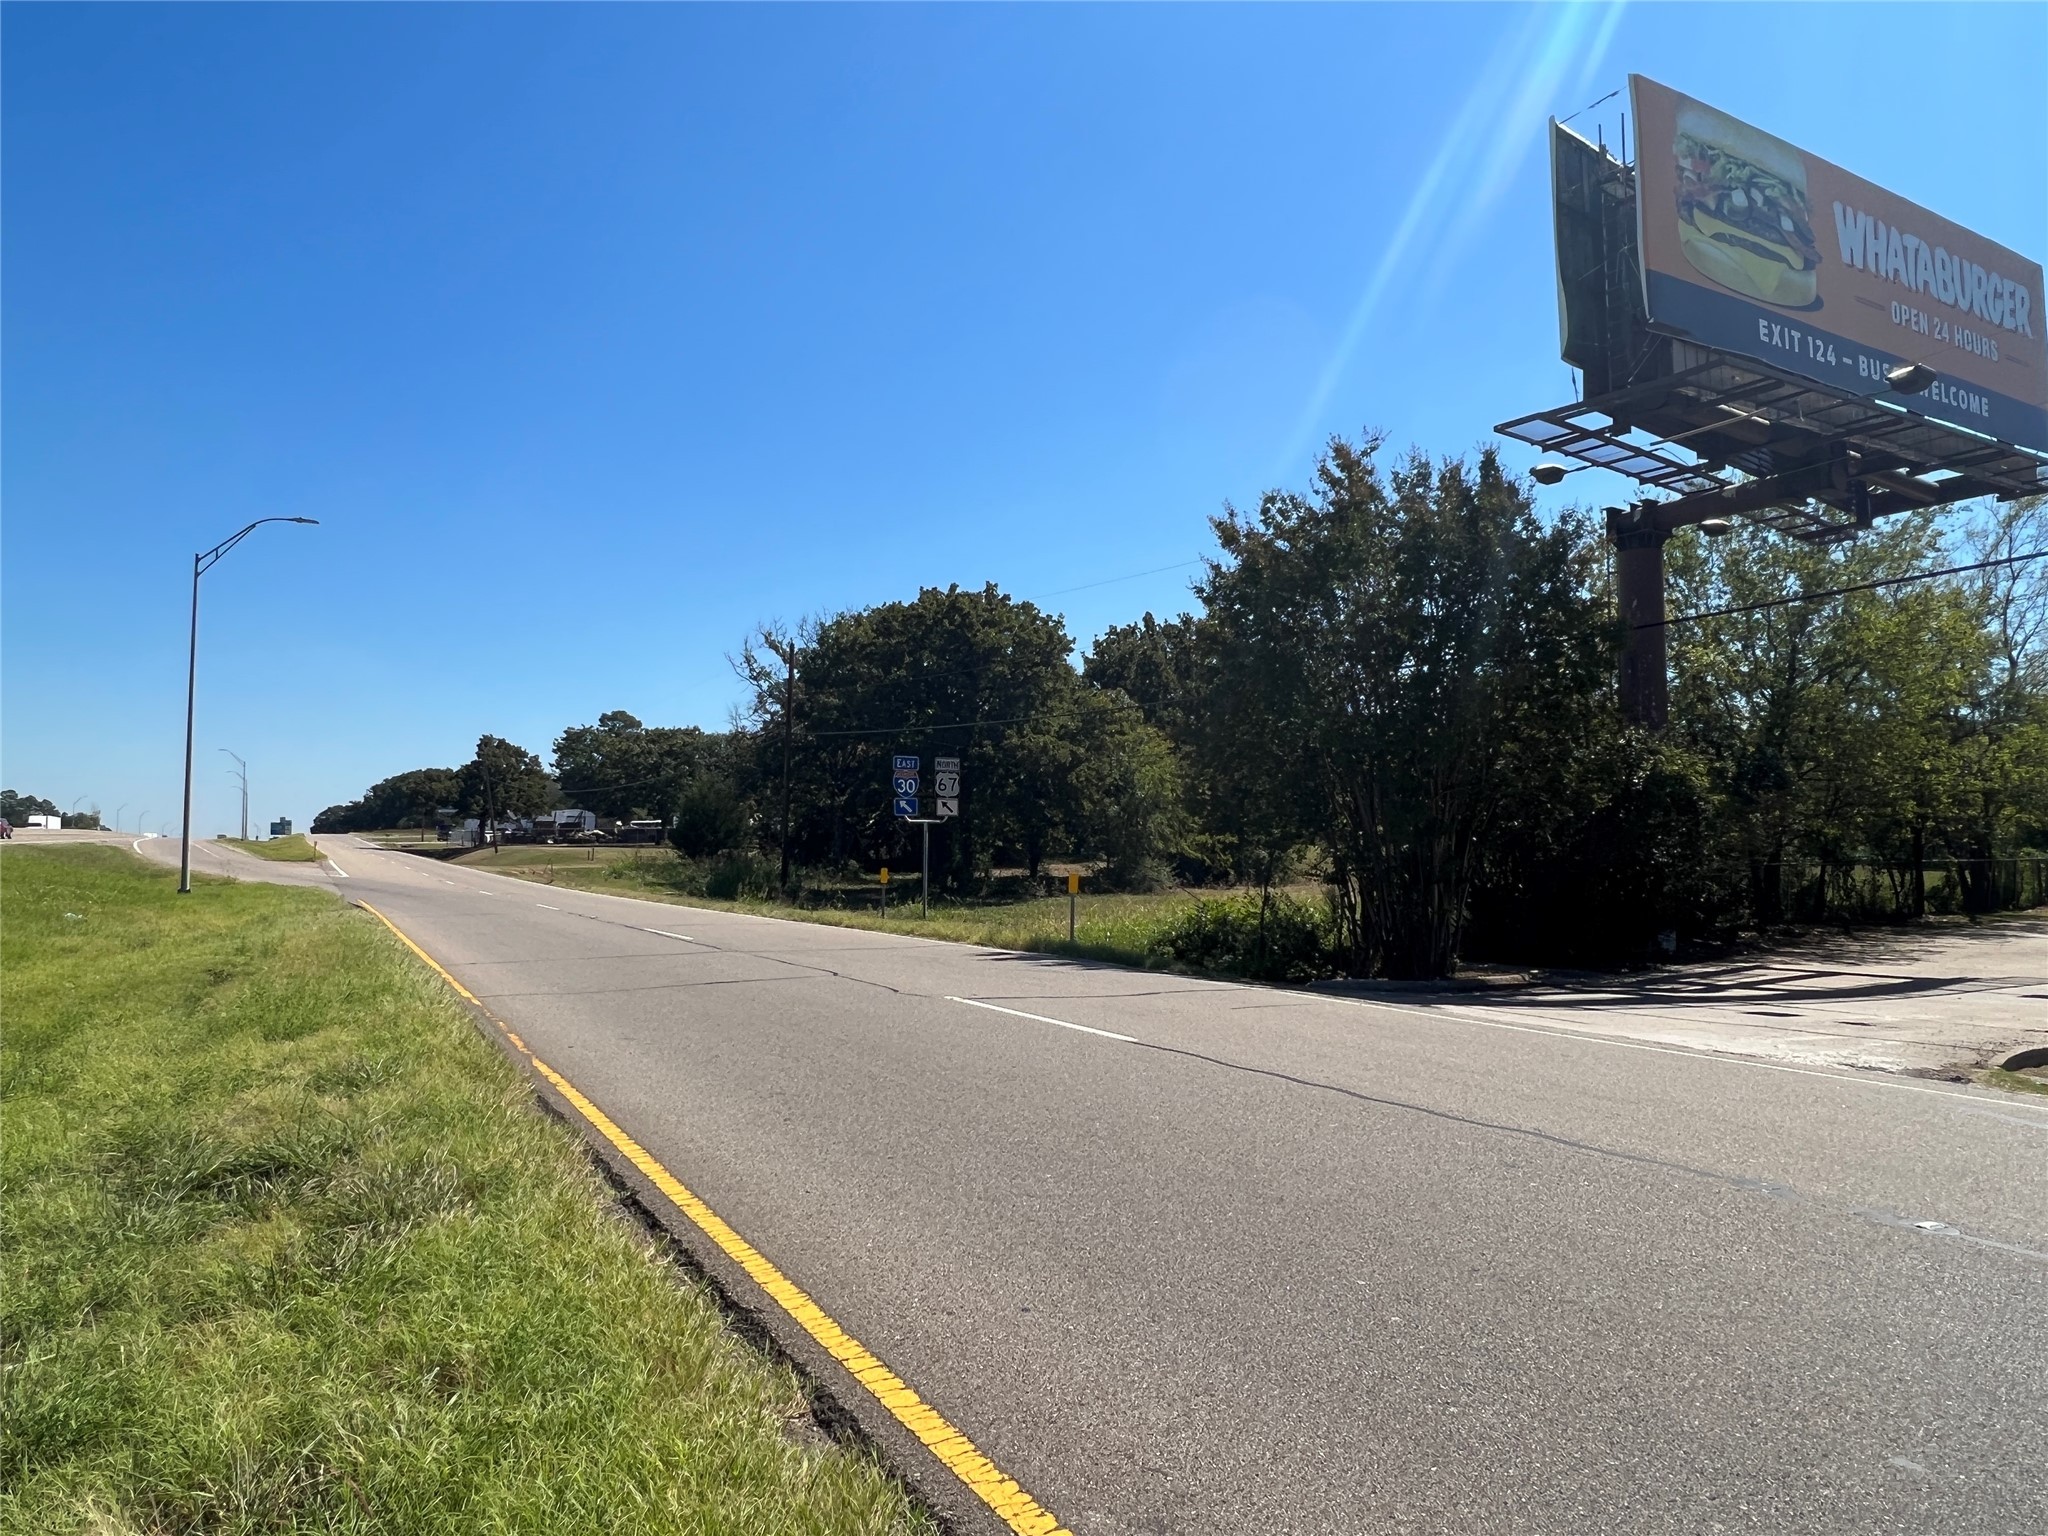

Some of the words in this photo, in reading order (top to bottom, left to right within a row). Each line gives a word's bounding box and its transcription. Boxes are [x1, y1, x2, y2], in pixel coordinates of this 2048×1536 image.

[1833, 200, 2034, 339] WHATABURGER
[1890, 300, 1929, 336] OPEN
[1933, 316, 1950, 343] 24
[1954, 326, 1999, 362] HOURS
[1758, 318, 1801, 353] EXIT
[1807, 336, 1837, 366] 124
[1858, 354, 1891, 384] BUS
[896, 758, 915, 768] EAST
[936, 760, 959, 769] NORTH
[897, 779, 916, 793] 30
[938, 777, 957, 792] 67
